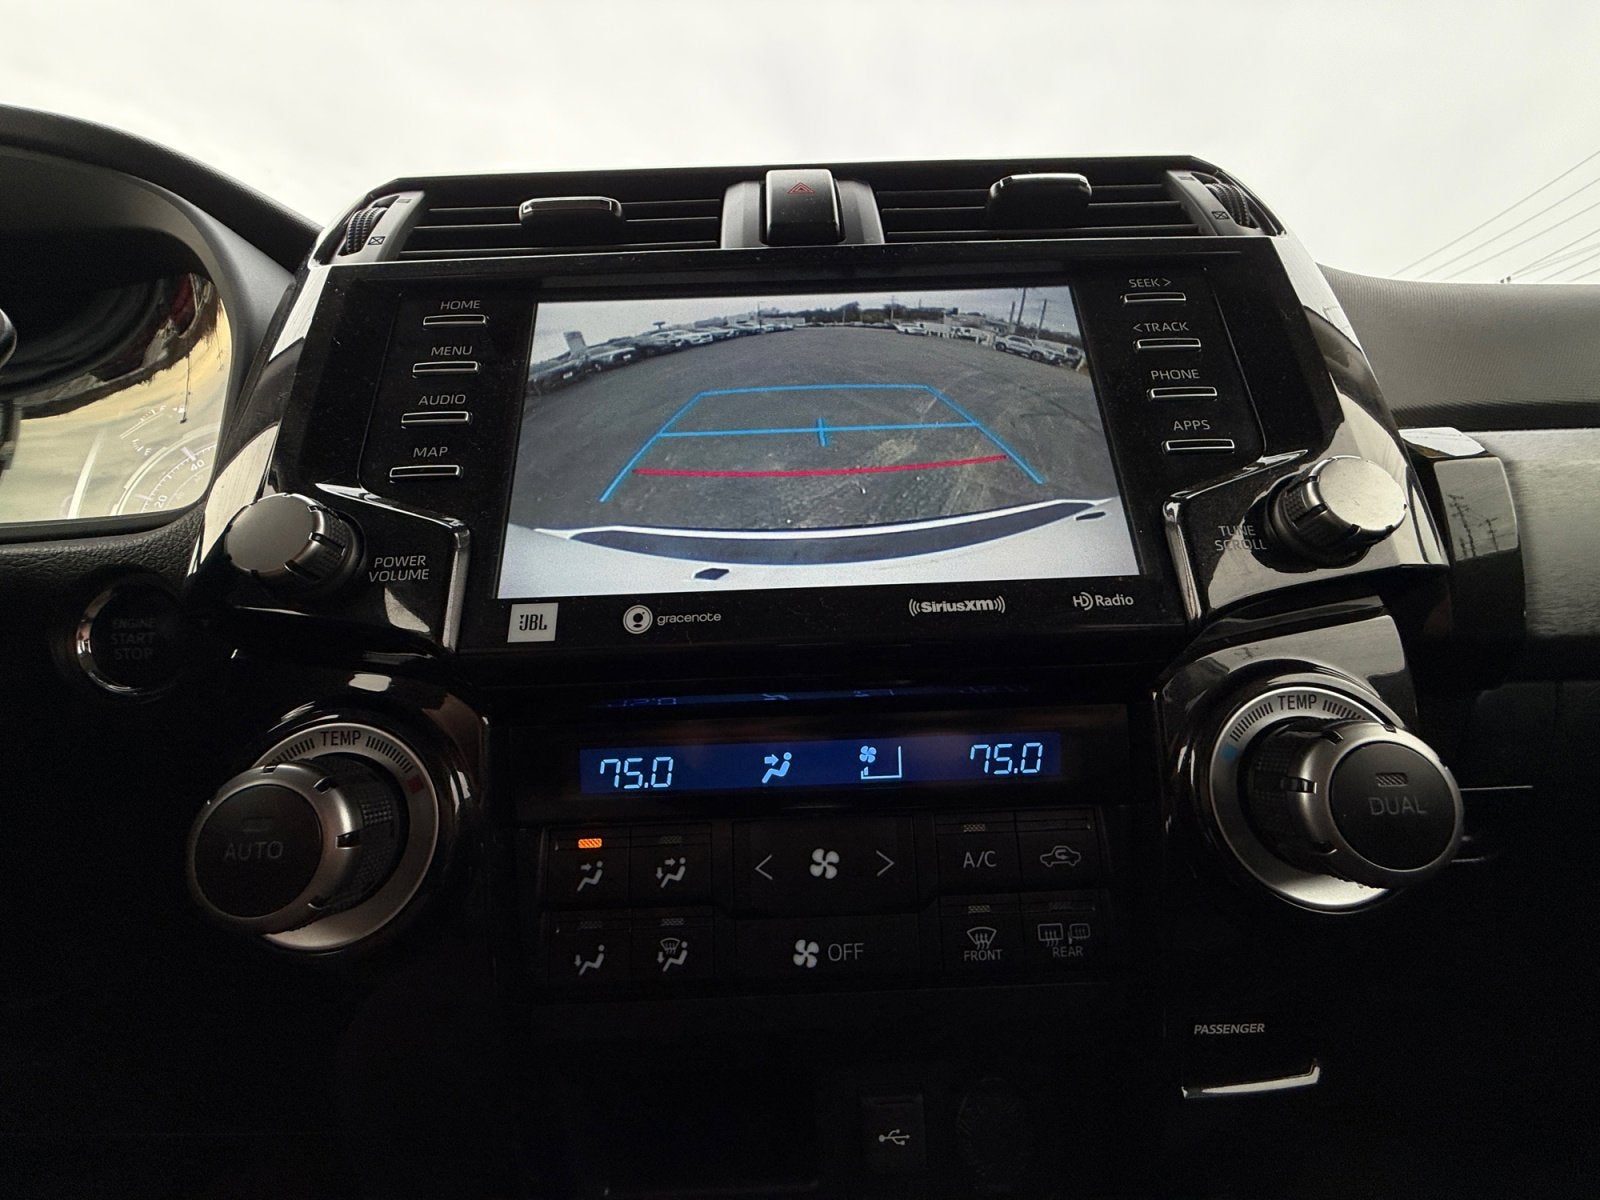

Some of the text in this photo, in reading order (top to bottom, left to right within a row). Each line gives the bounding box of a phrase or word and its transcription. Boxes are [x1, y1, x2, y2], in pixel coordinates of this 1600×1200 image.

[440, 299, 481, 311] HOME
[431, 344, 473, 356] MENU
[1150, 368, 1200, 380] PHONE
[418, 393, 467, 406] AUDIO
[1172, 418, 1211, 431] APPS
[413, 446, 449, 458] MAP
[190, 459, 205, 472] 40
[154, 495, 168, 508] 20
[1217, 524, 1256, 537] TUNE
[1213, 537, 1268, 552] SCROLL
[374, 555, 426, 568] POWER
[368, 567, 430, 582] VOLUME
[656, 611, 723, 626] gracenote
[114, 648, 153, 661] STOP
[1277, 694, 1318, 710] TEMP
[320, 730, 362, 747] TEMP
[968, 741, 1043, 775] 75.0
[599, 756, 673, 790] 75.0
[1368, 795, 1428, 817] DUAL
[224, 840, 284, 860] AUTO
[962, 849, 997, 869] A/C
[826, 942, 864, 963] OFF
[963, 948, 1004, 962] FRONT
[1051, 945, 1084, 959] REAR
[1193, 1022, 1266, 1036] PASSENGER
